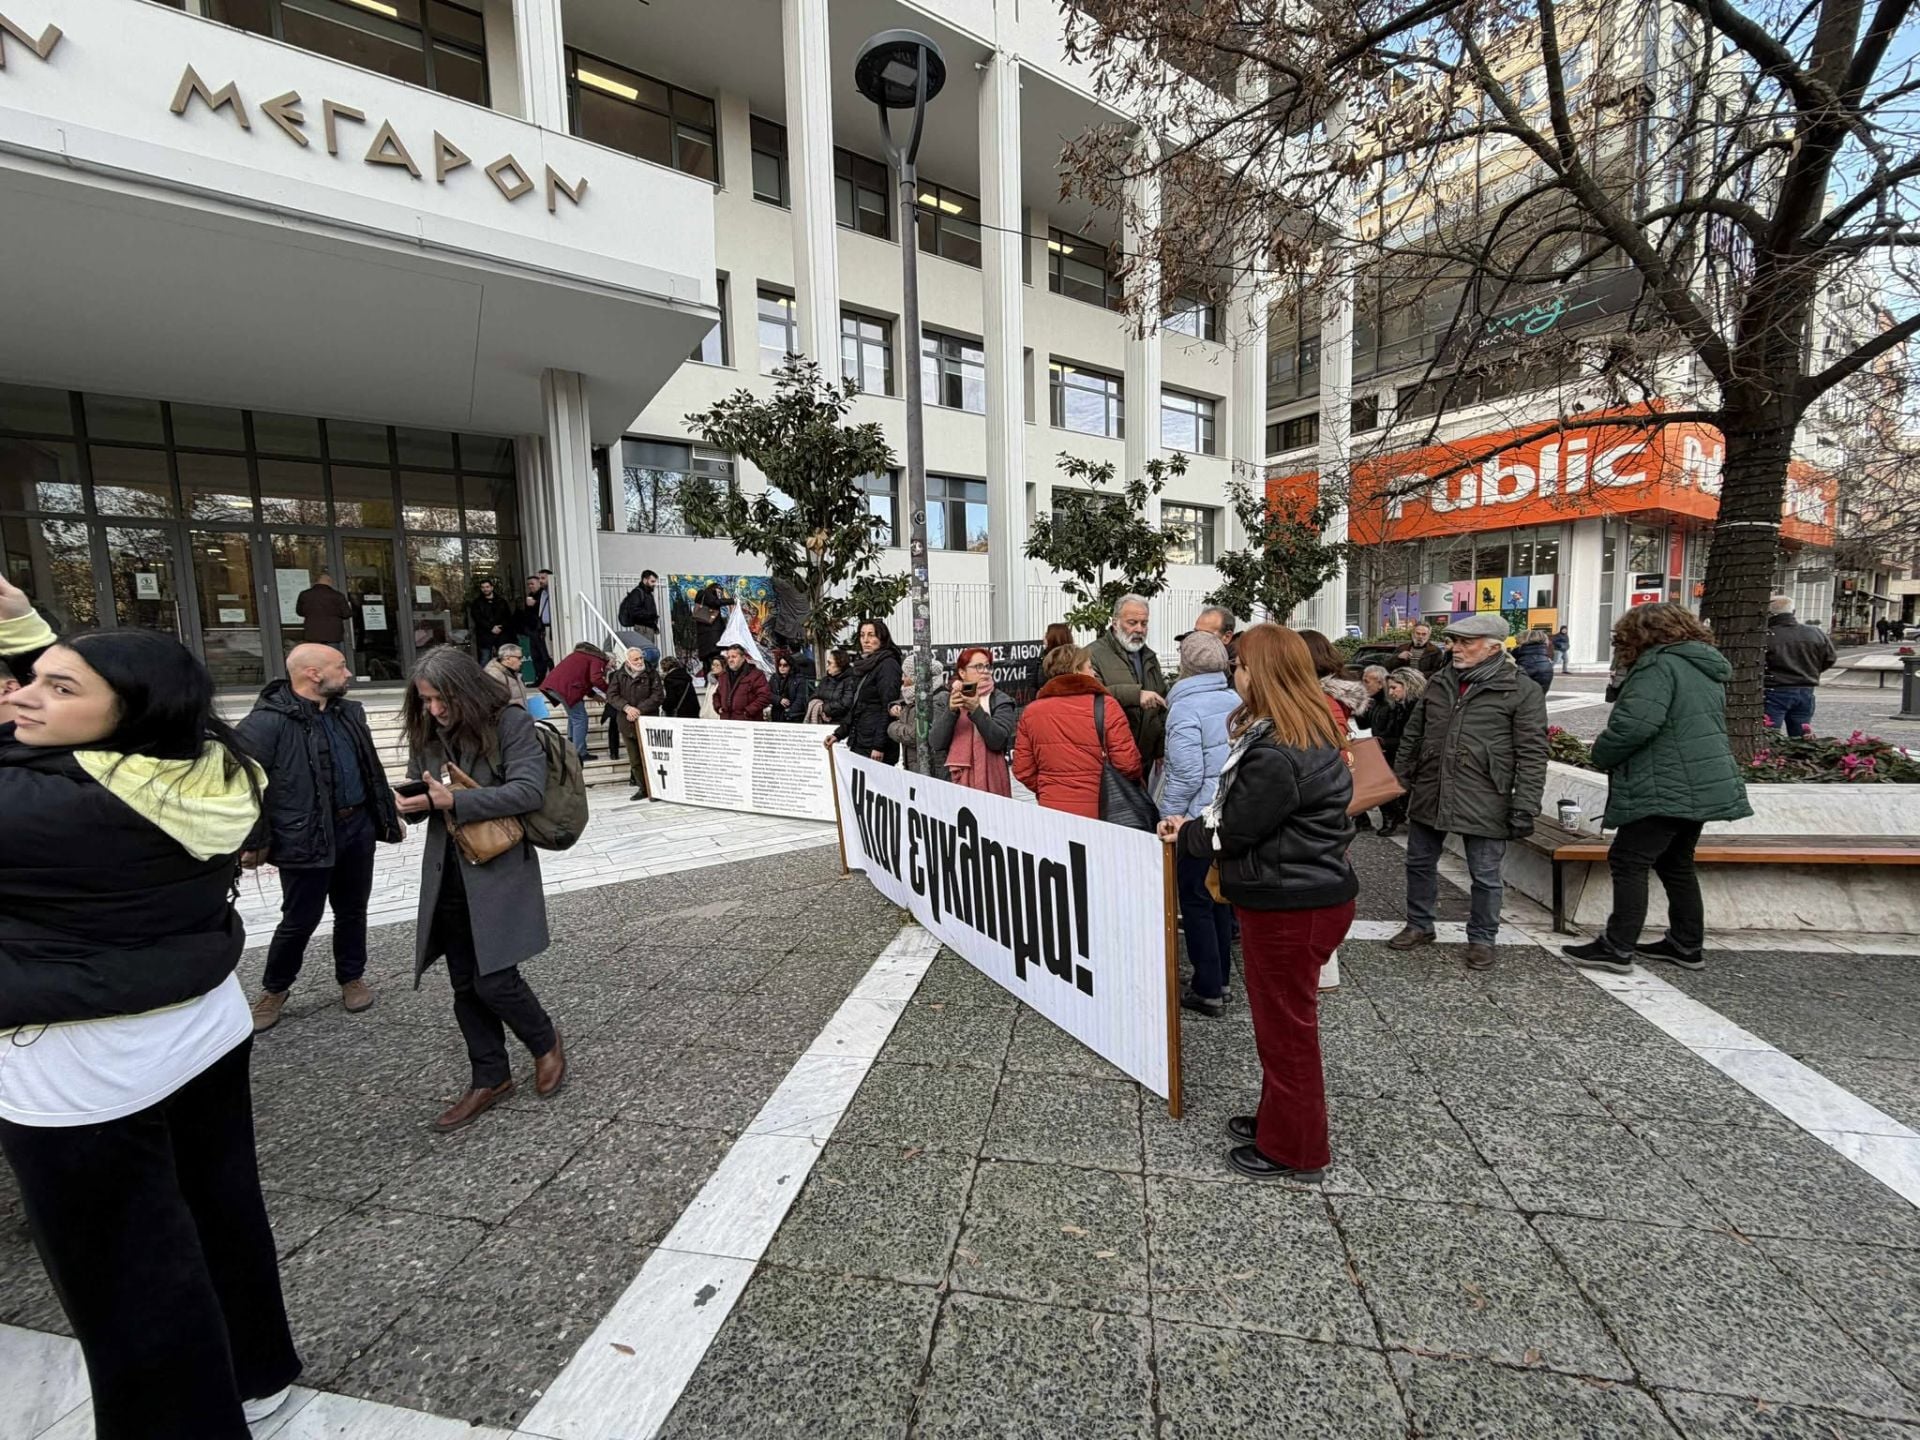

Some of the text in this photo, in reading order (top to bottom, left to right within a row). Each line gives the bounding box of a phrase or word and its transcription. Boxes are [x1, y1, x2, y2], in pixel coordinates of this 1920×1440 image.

[169, 62, 589, 213] ΜΕΓΑΡΟΝ
[1386, 435, 1647, 520] Public
[993, 665, 1027, 683] ΟΥΛΗ
[1010, 644, 1045, 661] ΑΙΘΟΥ
[646, 728, 673, 748] ΤΕΜΠΗ
[907, 787, 1094, 998] έγκλημα!
